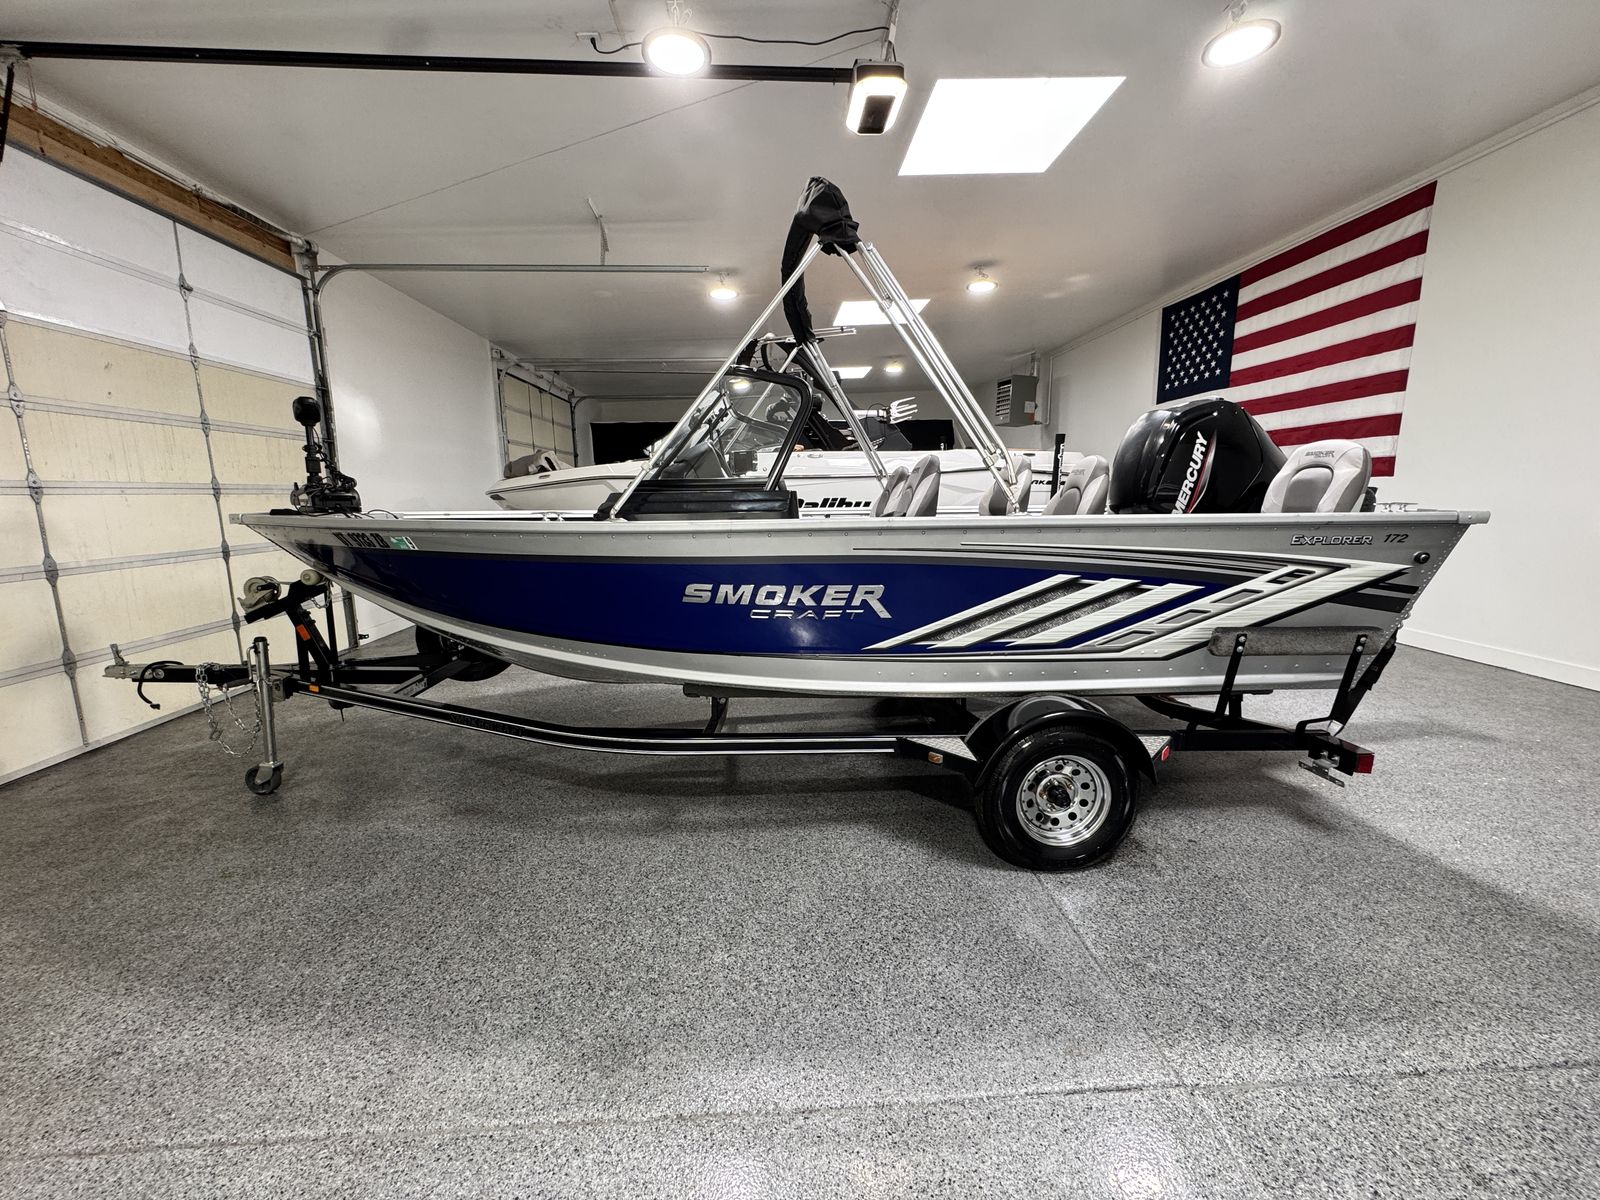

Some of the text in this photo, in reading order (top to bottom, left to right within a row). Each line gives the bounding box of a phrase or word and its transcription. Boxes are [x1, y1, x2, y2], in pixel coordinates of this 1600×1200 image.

[1171, 431, 1208, 514] MERCURY
[798, 498, 872, 509] alibu
[1290, 533, 1409, 546] EXPLORER 172
[682, 583, 893, 619] SMOKER
[750, 609, 865, 620] CRAFT
